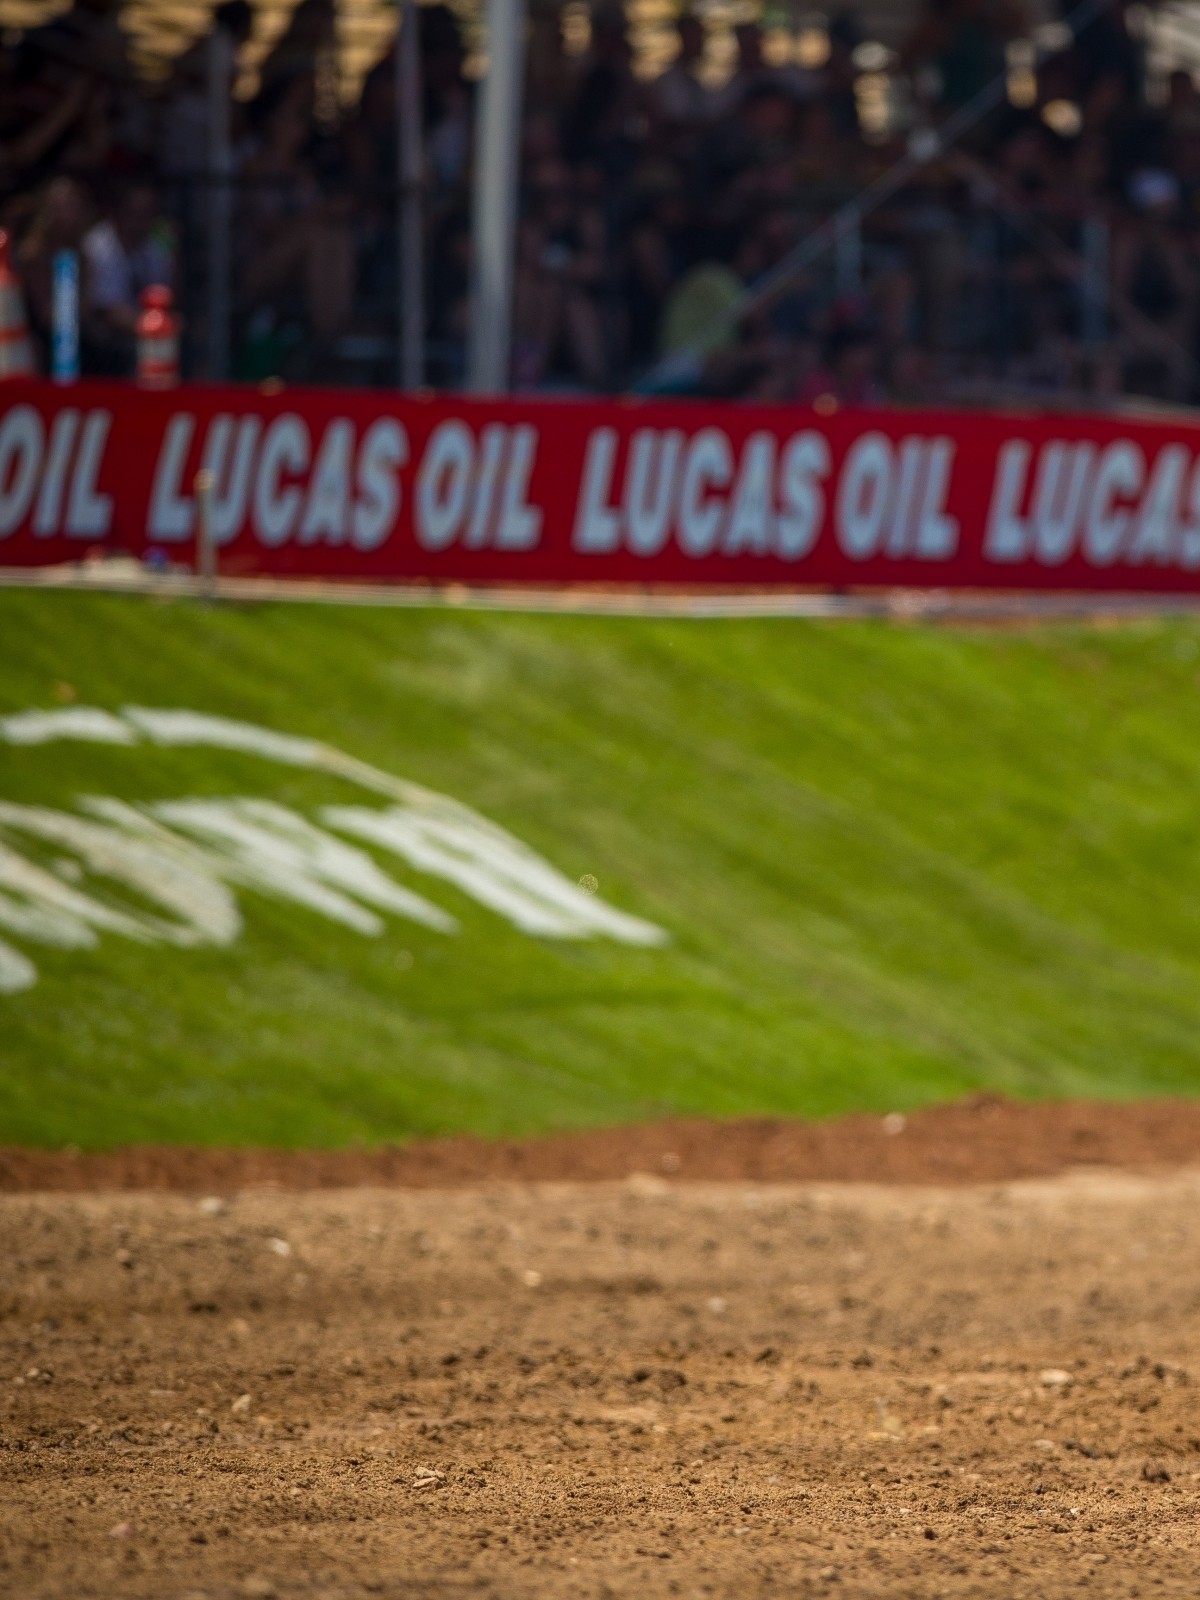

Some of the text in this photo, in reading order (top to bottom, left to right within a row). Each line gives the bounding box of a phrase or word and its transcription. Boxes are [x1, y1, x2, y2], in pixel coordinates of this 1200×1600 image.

[146, 410, 543, 552] LUCAS OIL
[572, 425, 960, 562] LUCAS OIL
